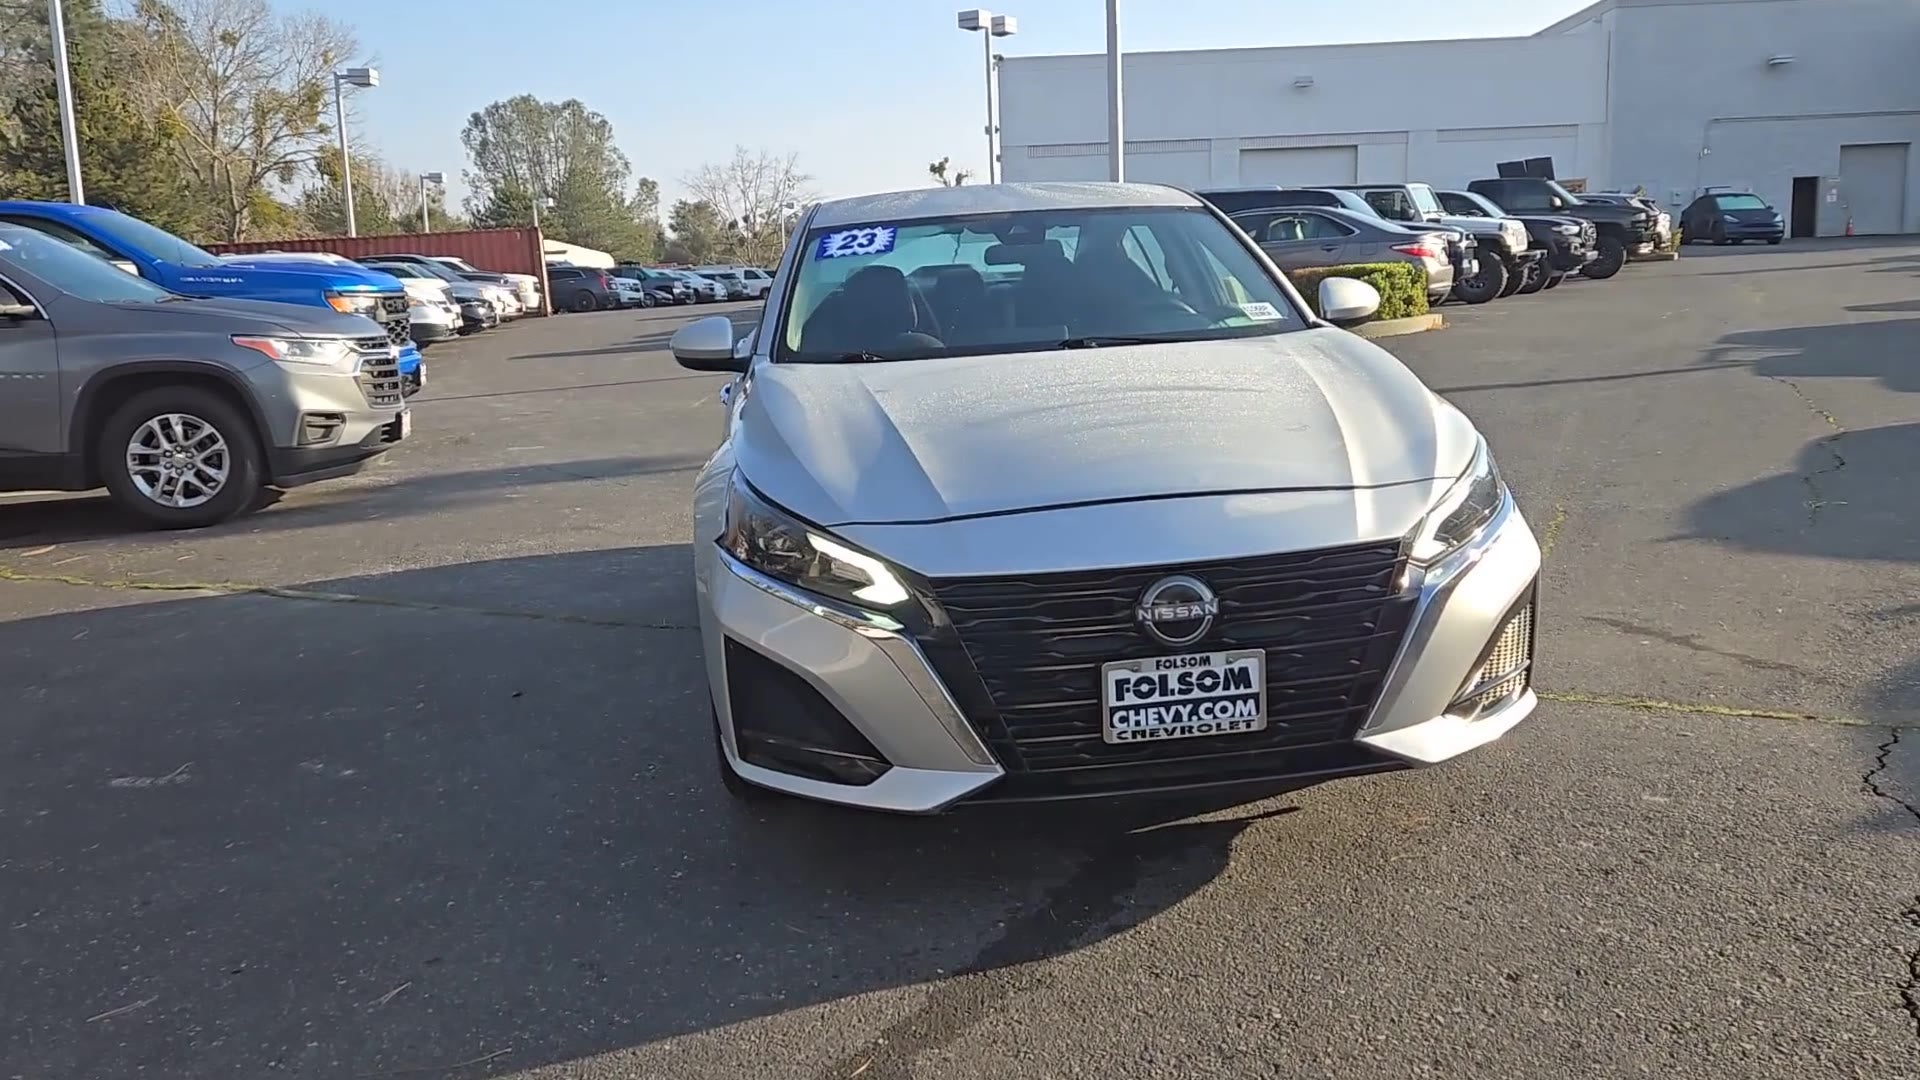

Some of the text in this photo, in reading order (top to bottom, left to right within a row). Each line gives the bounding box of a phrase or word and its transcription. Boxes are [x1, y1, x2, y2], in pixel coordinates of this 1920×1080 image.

[836, 232, 878, 250] 23
[1138, 602, 1218, 621] NISSAN
[1155, 656, 1212, 670] FOLSOM
[1115, 666, 1253, 702] FOLSOM
[1112, 699, 1257, 728] CHEVY.COM
[1116, 719, 1256, 740] CHEVROLET
